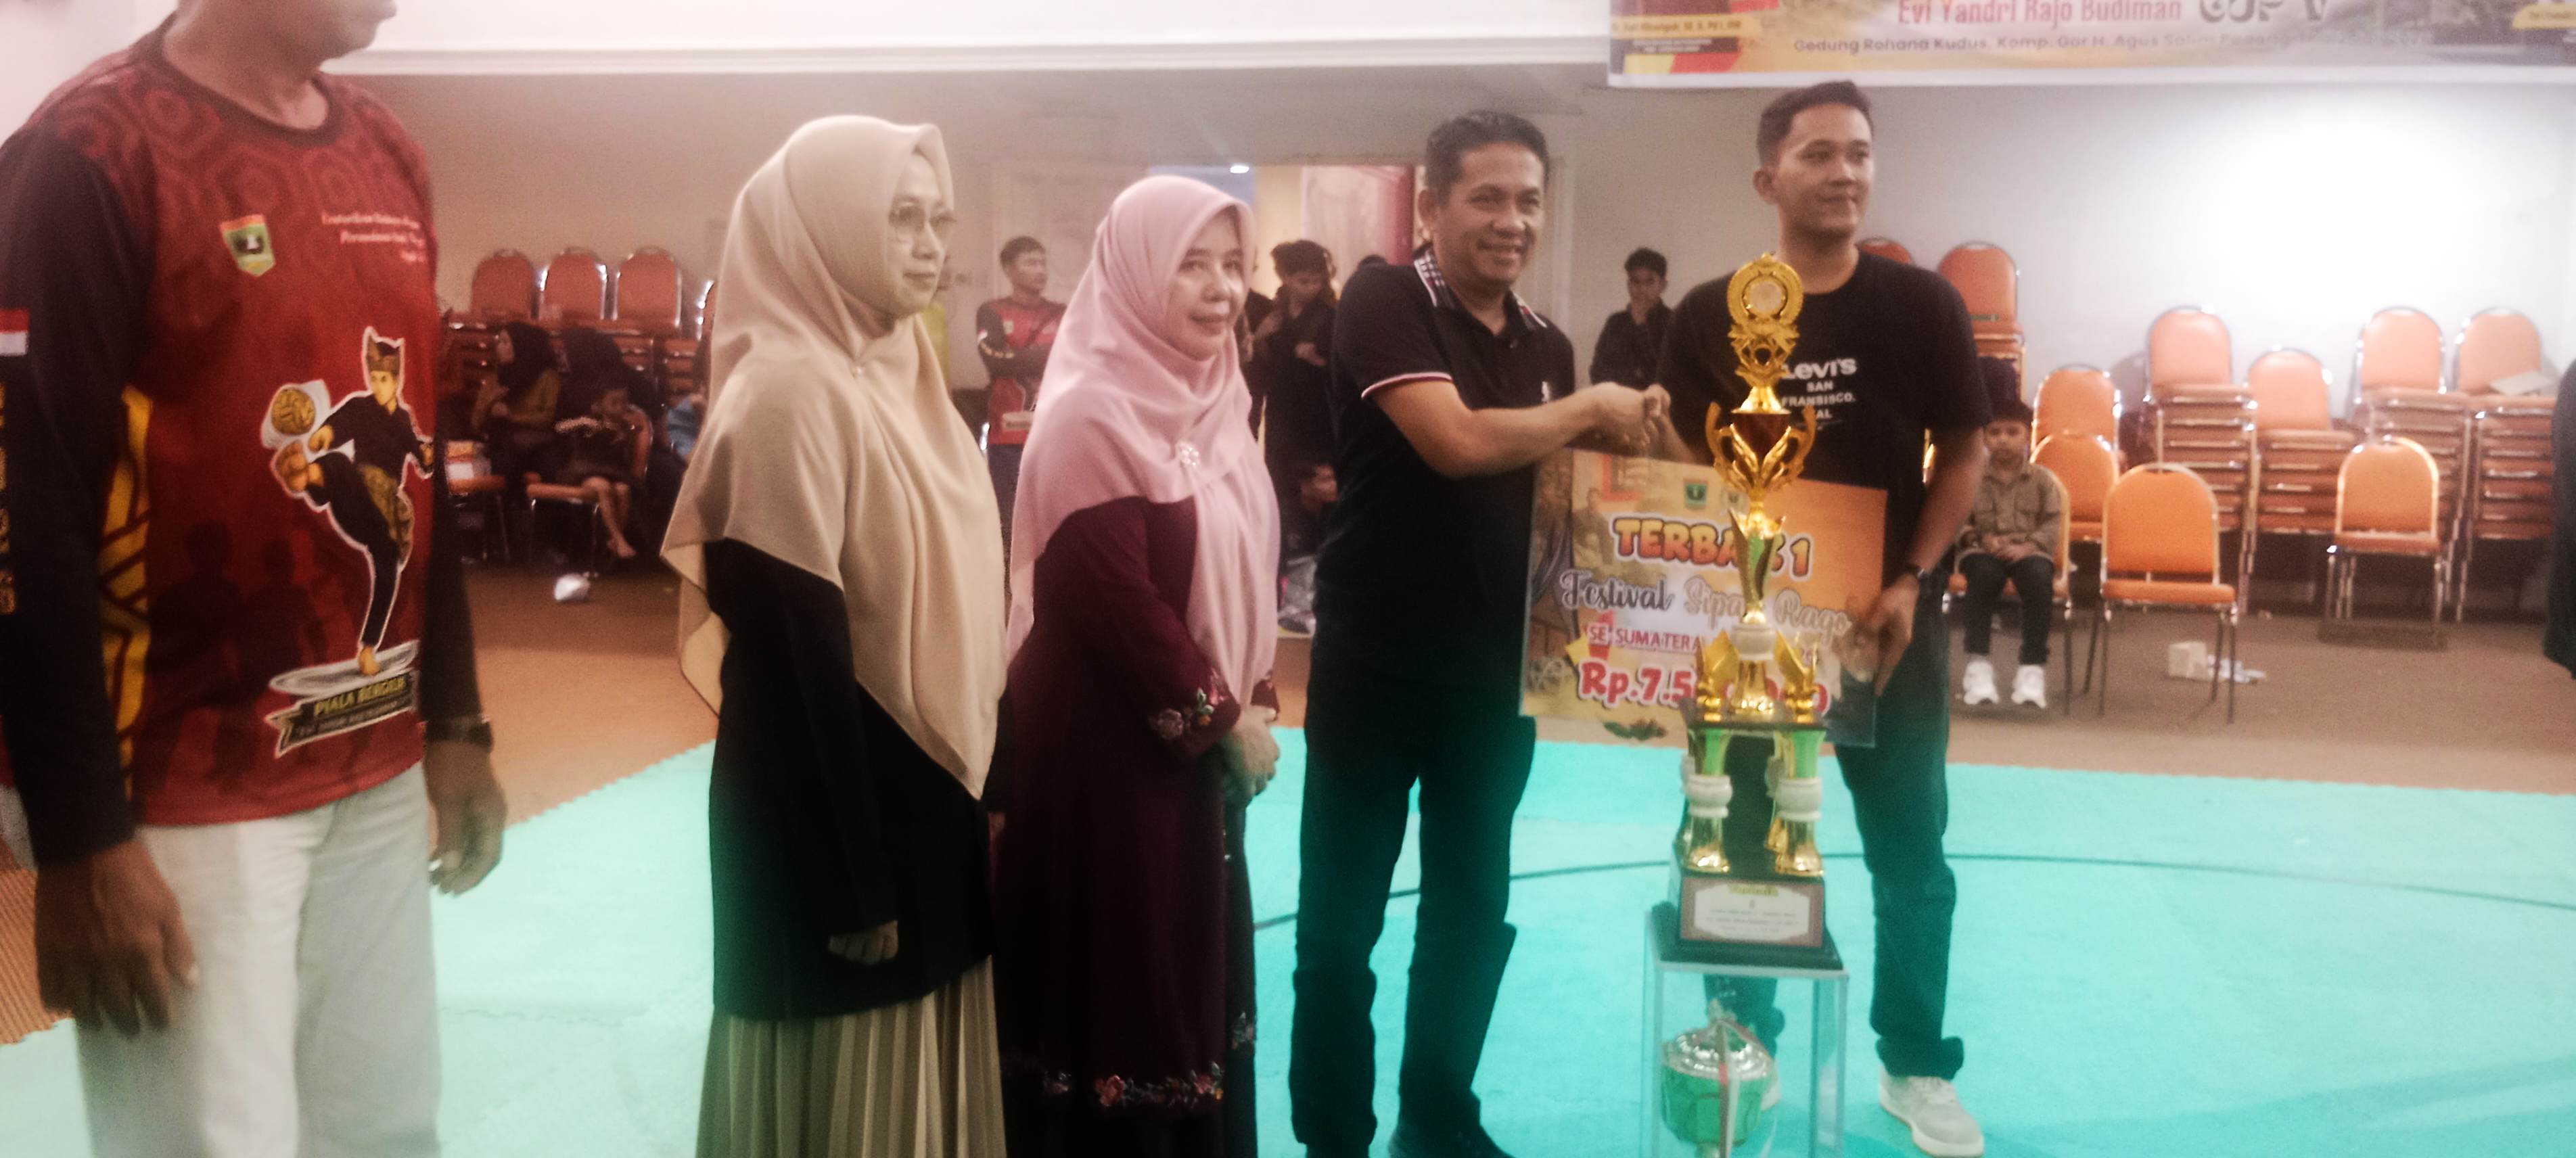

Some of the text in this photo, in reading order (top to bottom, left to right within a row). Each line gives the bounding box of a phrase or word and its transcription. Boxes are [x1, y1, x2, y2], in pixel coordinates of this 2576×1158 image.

[2024, 0, 2073, 30] Rajo
[2081, 0, 2182, 22] Budiman
[1793, 39, 1860, 54] Gedung
[1864, 37, 1929, 51] Rohana
[2113, 34, 2159, 49] Agus
[1806, 381, 1833, 393] SAN
[1612, 517, 1811, 576] TERBA 1
[1559, 570, 1676, 611] Festival
[1684, 577, 1752, 630] Sipa
